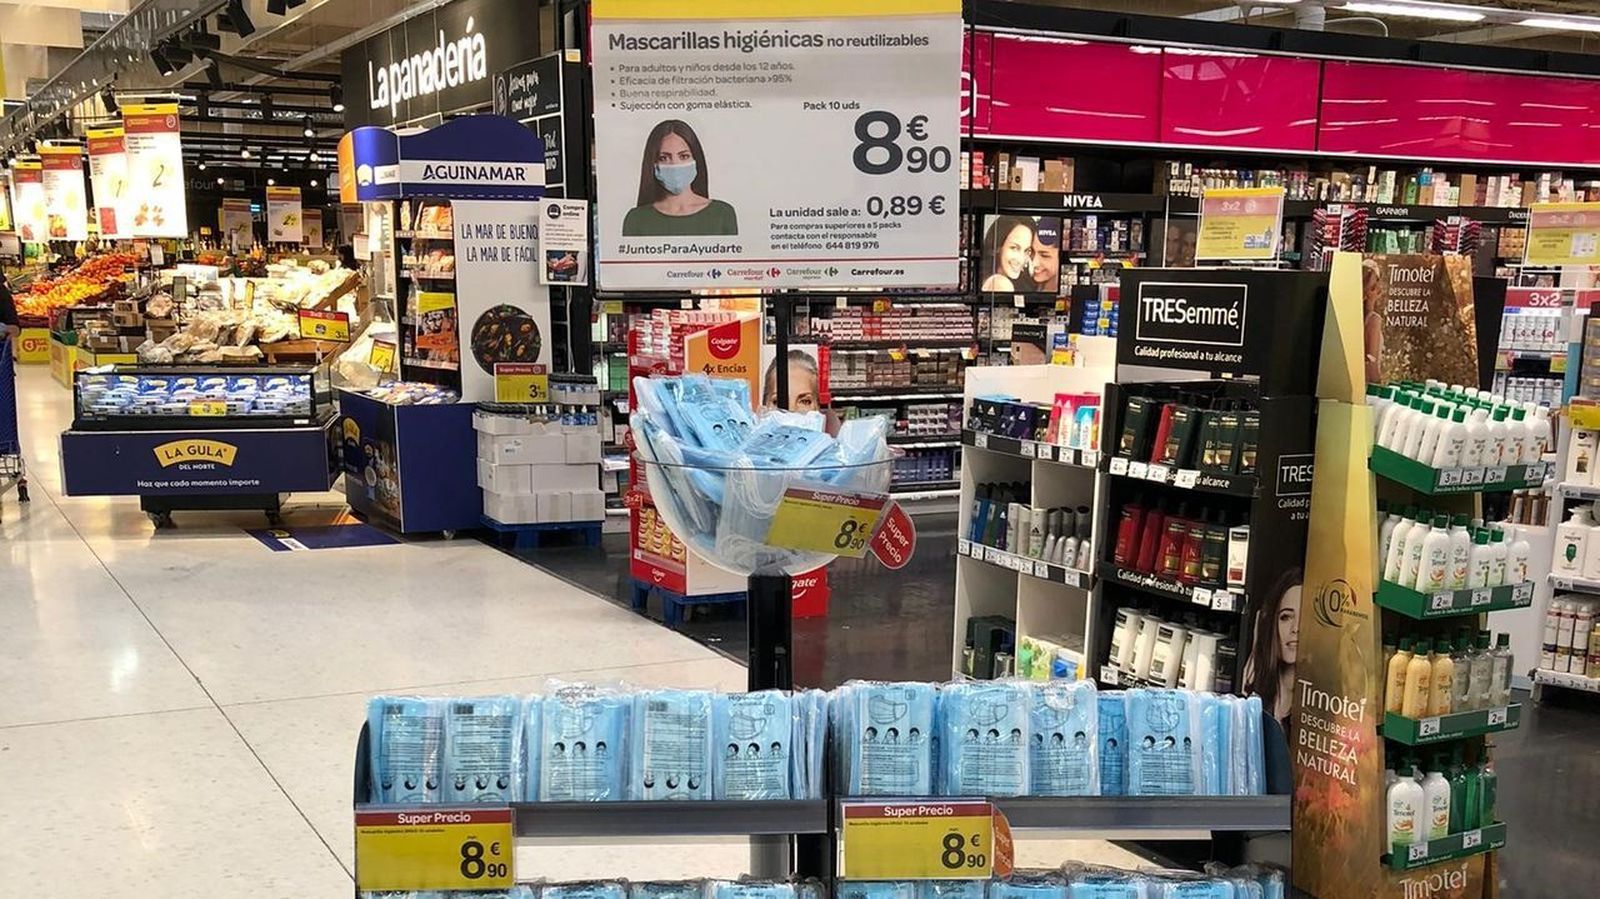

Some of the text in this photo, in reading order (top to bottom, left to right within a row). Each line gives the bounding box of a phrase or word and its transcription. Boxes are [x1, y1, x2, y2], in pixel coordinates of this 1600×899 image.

[608, 30, 929, 52] Mascarillas higiénicas no reutilizables
[368, 15, 487, 118] La panadería
[619, 64, 640, 73] Para
[642, 64, 676, 73] adultos
[678, 65, 684, 73] y
[686, 63, 711, 72] niños
[713, 62, 744, 72] desde
[746, 62, 757, 71] los
[759, 62, 769, 71] 12
[619, 77, 656, 86] Eficacia
[658, 77, 670, 85] de
[672, 76, 713, 85] filtración
[715, 75, 765, 84] bacteriana
[620, 88, 717, 99] Buena respirabilidad.
[620, 100, 752, 112] Sujección con goma elástica.
[804, 101, 860, 111] Pack 10 uds
[853, 110, 951, 175] 8 € 90
[423, 165, 525, 181] AGUINAMAR
[866, 196, 946, 218] 0,89 €
[1063, 195, 1103, 208] NIVEA
[1222, 200, 1241, 212] 3x2
[770, 206, 861, 218] La unidad sale a:
[462, 224, 473, 239] LA
[475, 225, 493, 240] MAR
[496, 225, 507, 240] DE
[770, 222, 788, 231] Para
[790, 223, 823, 232] compras
[825, 222, 866, 232] superiores
[770, 232, 805, 241] contacta
[820, 232, 828, 240] el
[829, 231, 877, 242] responsable
[618, 244, 743, 256] #JuntosParaAyudarte
[781, 242, 789, 250] el
[789, 242, 822, 250] teléfono
[826, 242, 843, 250] 644
[467, 245, 538, 262] LA MAR DE FÁCIL
[667, 267, 905, 279] Carrefour Carrefour Carrefour Carrefour.es
[1388, 264, 1437, 285] Timotei
[1422, 288, 1431, 297] LA
[1529, 292, 1560, 306] 3x2
[1142, 298, 1239, 326] TRESemmé
[1388, 300, 1430, 312] BELLEZA
[1386, 316, 1428, 327] NATURAL
[711, 338, 739, 346] Colgate
[1134, 345, 1160, 357] Calidad
[1160, 348, 1199, 360] profesional
[1206, 352, 1214, 360] tu
[1214, 351, 1243, 363] alcance
[164, 444, 225, 460] LA GULA
[138, 480, 153, 488] Haz
[229, 479, 260, 488] importe
[1202, 476, 1230, 489] alcance
[812, 491, 836, 503] Super
[836, 494, 860, 506] Precio
[834, 520, 869, 550] 8 € 90
[887, 517, 910, 547] Super
[878, 531, 903, 564] Precio
[1118, 568, 1142, 584] Calidad
[1437, 597, 1443, 608] 2
[1298, 679, 1367, 723] Timotei
[1492, 714, 1498, 724] 2
[1300, 712, 1360, 742] DESCUBRE LA
[1424, 724, 1430, 734] 2
[1299, 728, 1358, 765] BELLEZA
[1297, 750, 1356, 786] NATURAL
[398, 811, 472, 826] Super Precio
[884, 805, 954, 819] Super Precio
[1468, 836, 1473, 846] 3
[942, 833, 986, 869] 8 € 90
[1413, 848, 1419, 858] 3
[460, 841, 508, 879] 8 € 90
